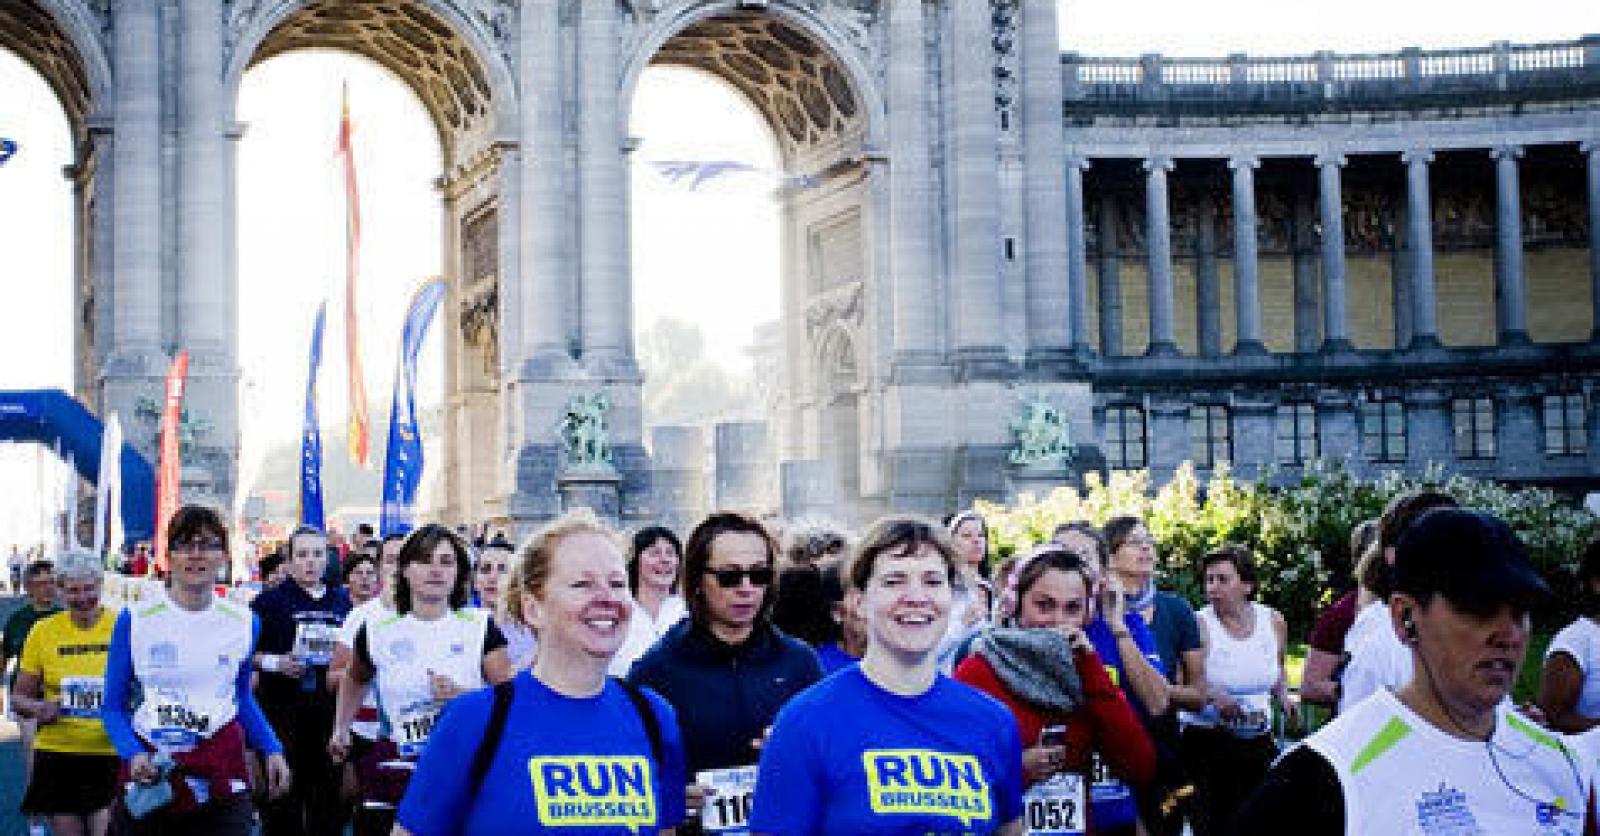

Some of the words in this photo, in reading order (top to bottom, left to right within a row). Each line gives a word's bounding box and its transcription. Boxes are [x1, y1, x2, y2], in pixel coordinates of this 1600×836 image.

[541, 761, 647, 797] RUN
[873, 754, 981, 790] RUN
[547, 801, 652, 818] BRUSSELS
[878, 791, 987, 814] BRUSSELS
